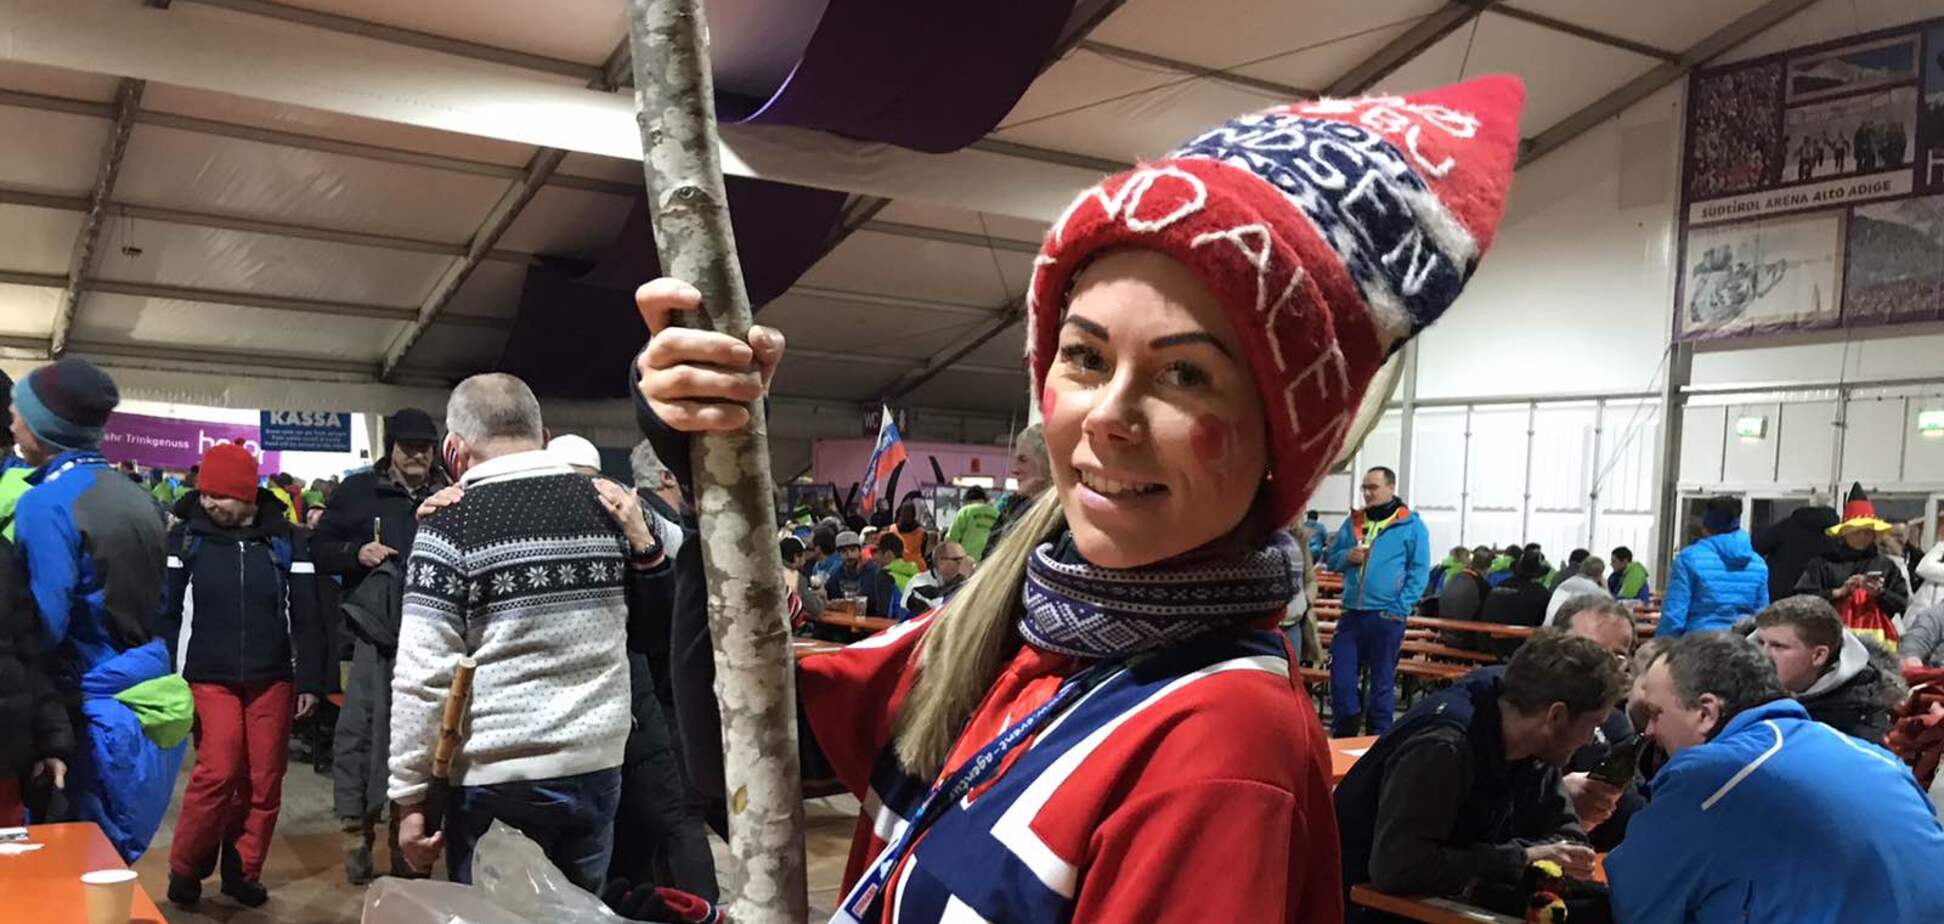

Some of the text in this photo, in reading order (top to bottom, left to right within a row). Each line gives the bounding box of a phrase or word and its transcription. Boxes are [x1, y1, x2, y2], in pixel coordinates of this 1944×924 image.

[1765, 193, 1809, 210] ARENA
[1850, 179, 1892, 199] ADIGE
[271, 410, 342, 427] KASSA
[126, 433, 190, 449] Trinkgenuss
